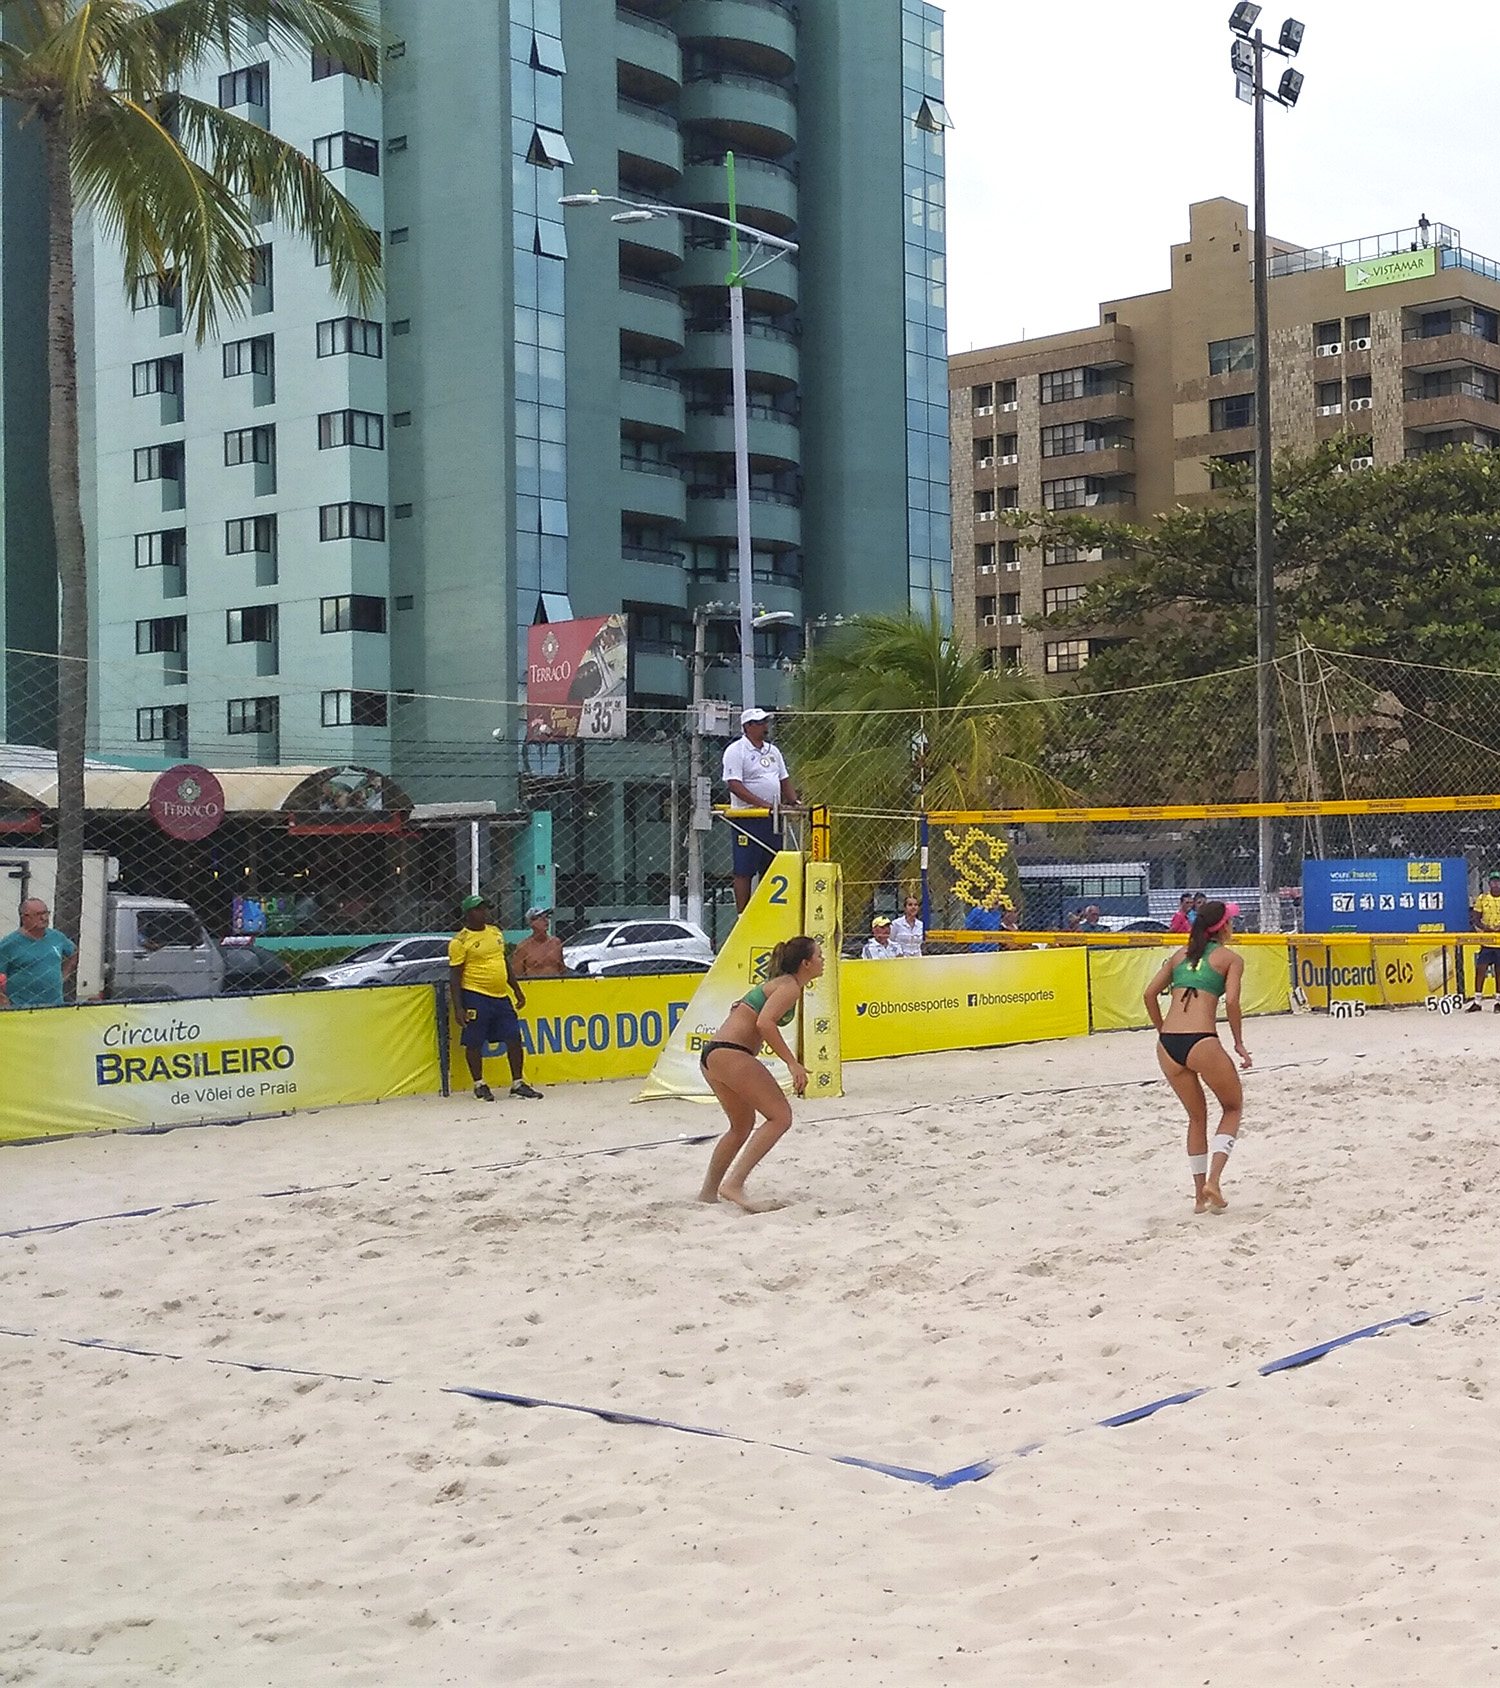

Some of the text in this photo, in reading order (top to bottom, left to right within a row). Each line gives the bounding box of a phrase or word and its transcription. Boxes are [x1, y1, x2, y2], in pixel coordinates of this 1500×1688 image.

[1373, 258, 1425, 276] VISTAMAR
[768, 876, 788, 905] 2
[1421, 894, 1440, 909] 11
[867, 989, 1055, 1018] @bbnosesportes /bbnosesportes
[103, 1019, 201, 1047] Circuito
[616, 1010, 662, 1049] DO
[95, 1044, 295, 1087] BRASILEIRO
[171, 1080, 297, 1105] de Vôlei de Praia
